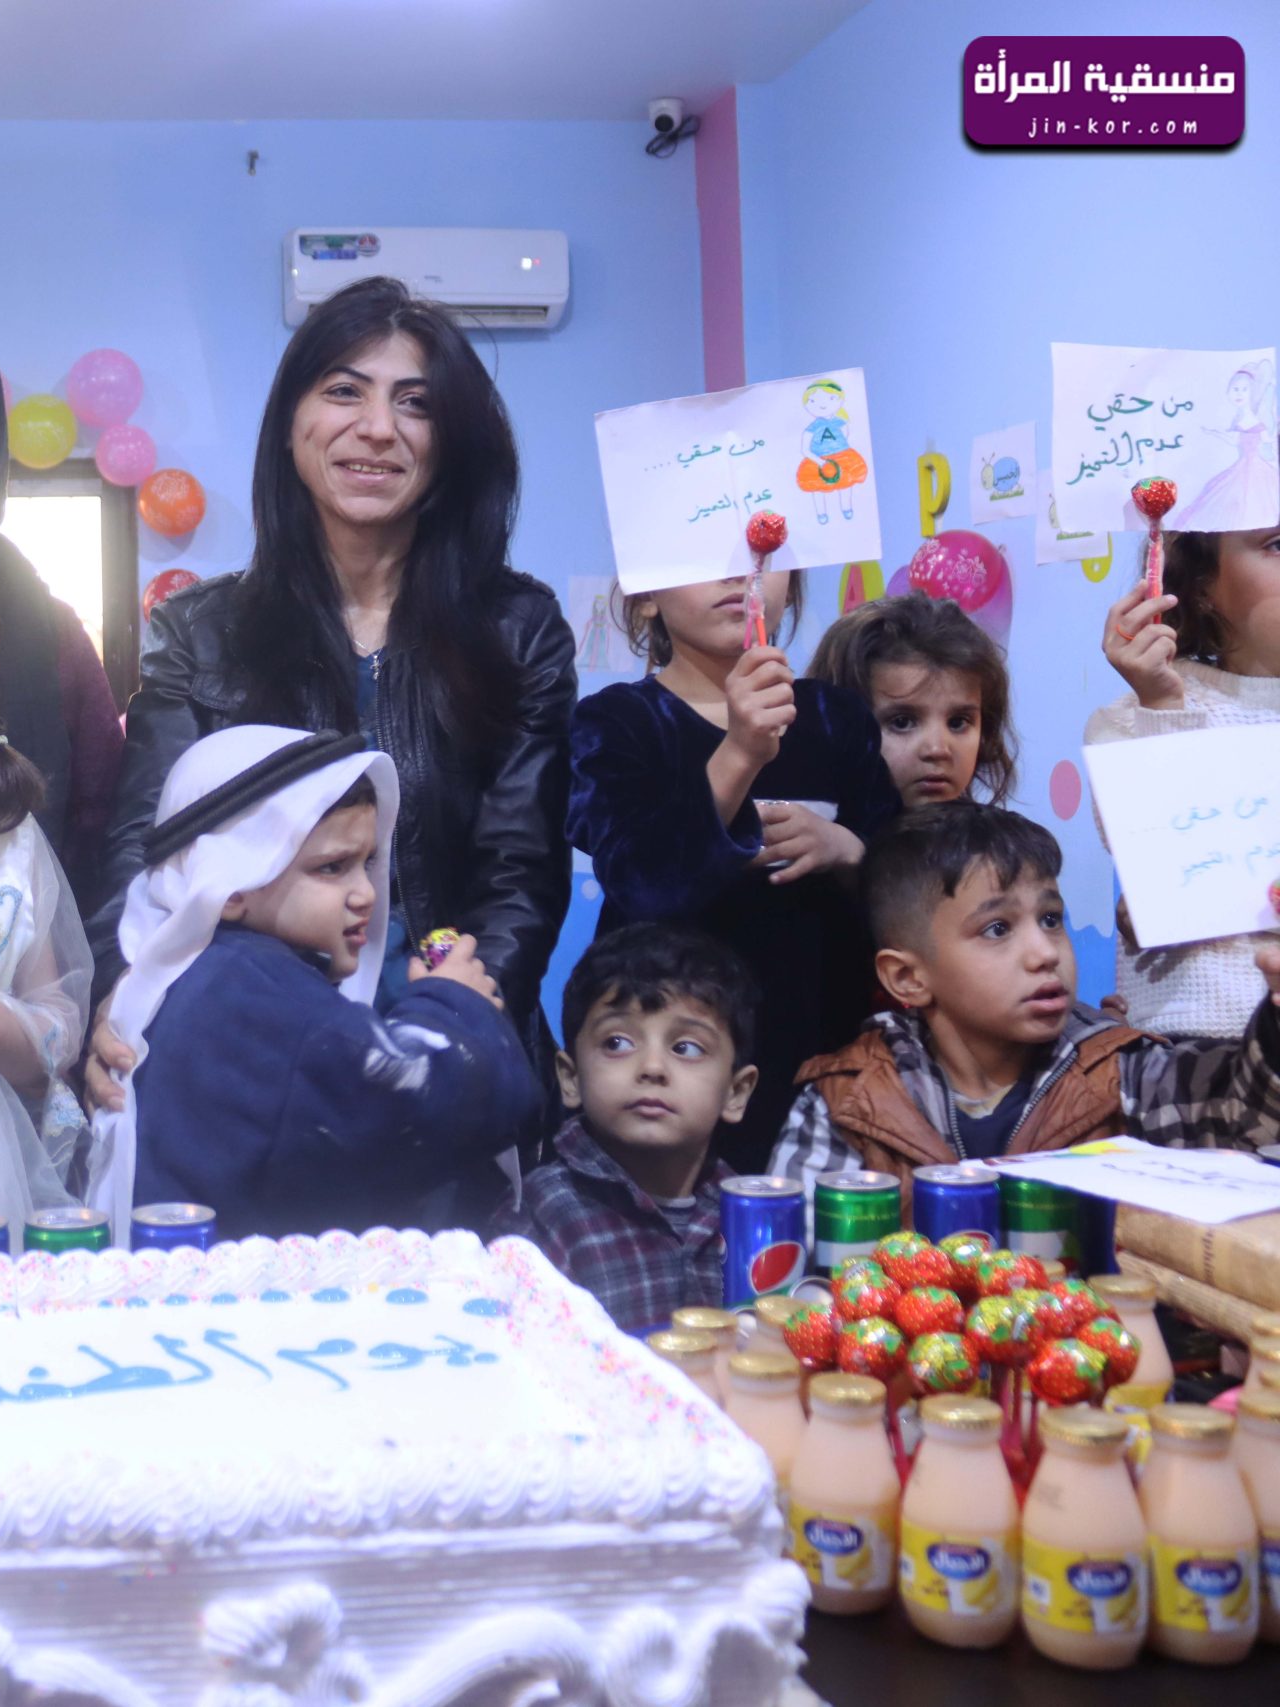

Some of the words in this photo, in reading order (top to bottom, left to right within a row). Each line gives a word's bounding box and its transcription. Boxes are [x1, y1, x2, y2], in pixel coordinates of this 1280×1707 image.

[1087, 393, 1154, 431] حقي
[1161, 396, 1194, 418] من
[677, 444, 722, 468] حقي
[729, 439, 765, 456] من
[1136, 434, 1184, 465] عدم
[743, 488, 773, 514] عدم
